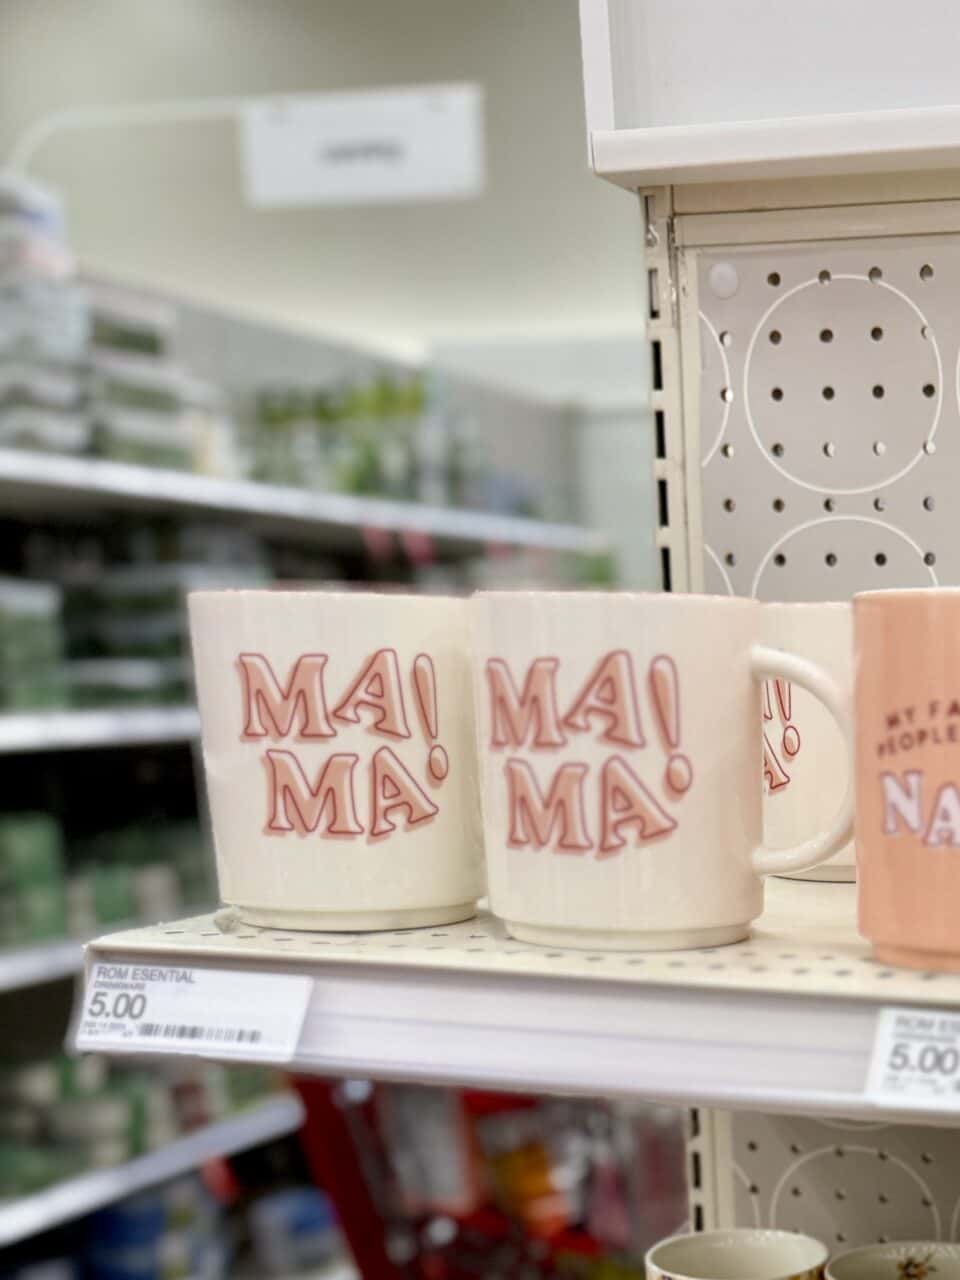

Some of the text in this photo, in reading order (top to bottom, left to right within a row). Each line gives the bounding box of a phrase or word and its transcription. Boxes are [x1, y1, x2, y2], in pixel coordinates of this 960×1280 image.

[235, 648, 449, 780] MA!
[485, 649, 693, 794] MA!
[886, 705, 915, 728] MY
[877, 723, 957, 757] PEOPLE
[262, 745, 438, 839] MA
[505, 753, 678, 857] MA
[96, 966, 195, 985] ROM ESENTIAL
[88, 991, 147, 1019] 5.00
[888, 1043, 960, 1076] 5.00
